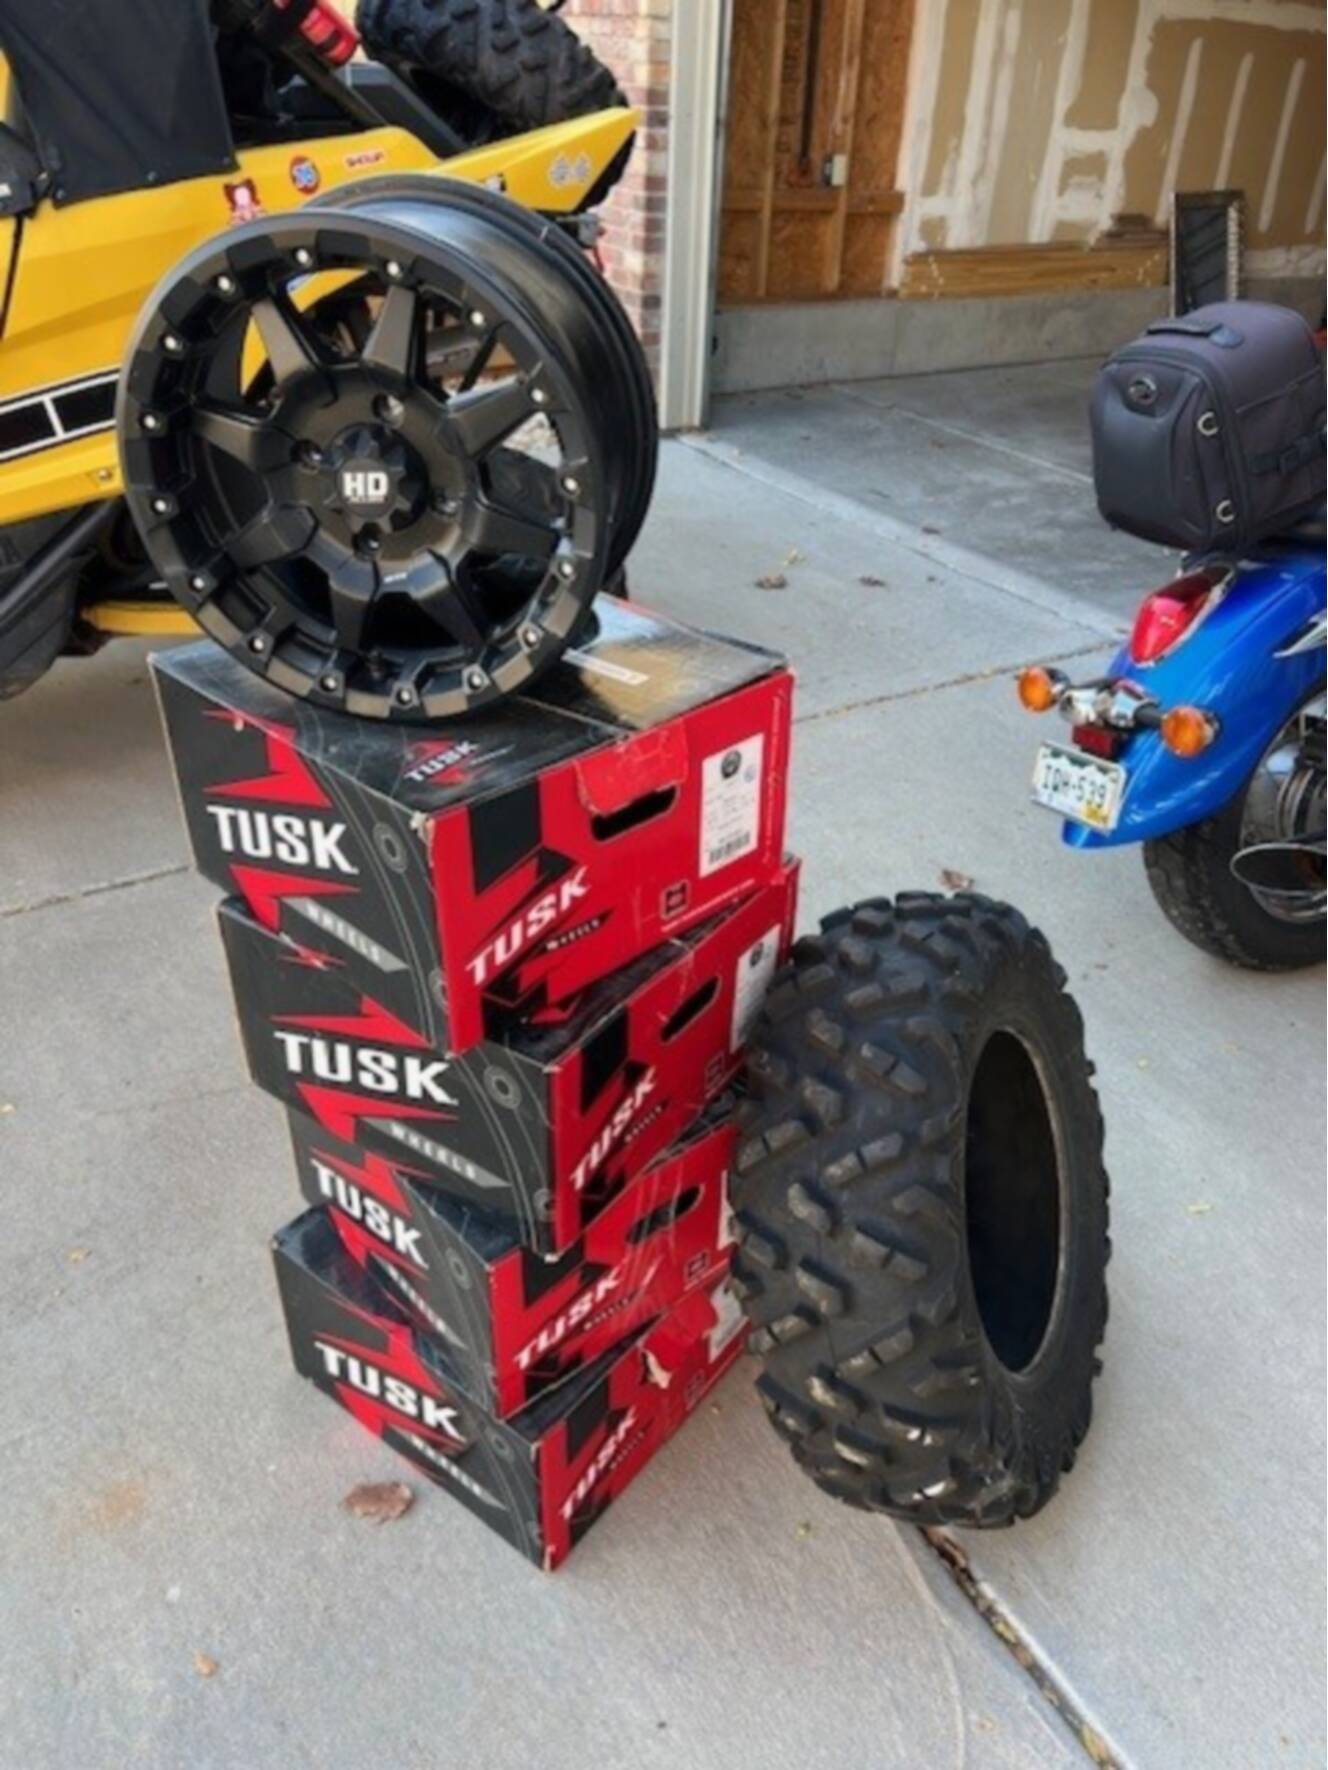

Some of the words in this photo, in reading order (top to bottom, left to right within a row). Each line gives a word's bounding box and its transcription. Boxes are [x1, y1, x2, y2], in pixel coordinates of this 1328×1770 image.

[343, 471, 388, 497] HD
[404, 741, 479, 781] TUSK
[207, 806, 358, 875] TUSK
[466, 866, 591, 985] TUSK
[274, 1031, 459, 1105] TUSK
[570, 1066, 655, 1190] TUSK
[310, 1158, 429, 1269] TUSK
[514, 1266, 620, 1370] TUSK
[314, 1341, 467, 1443] TUSK
[560, 1406, 636, 1519] TUSK
